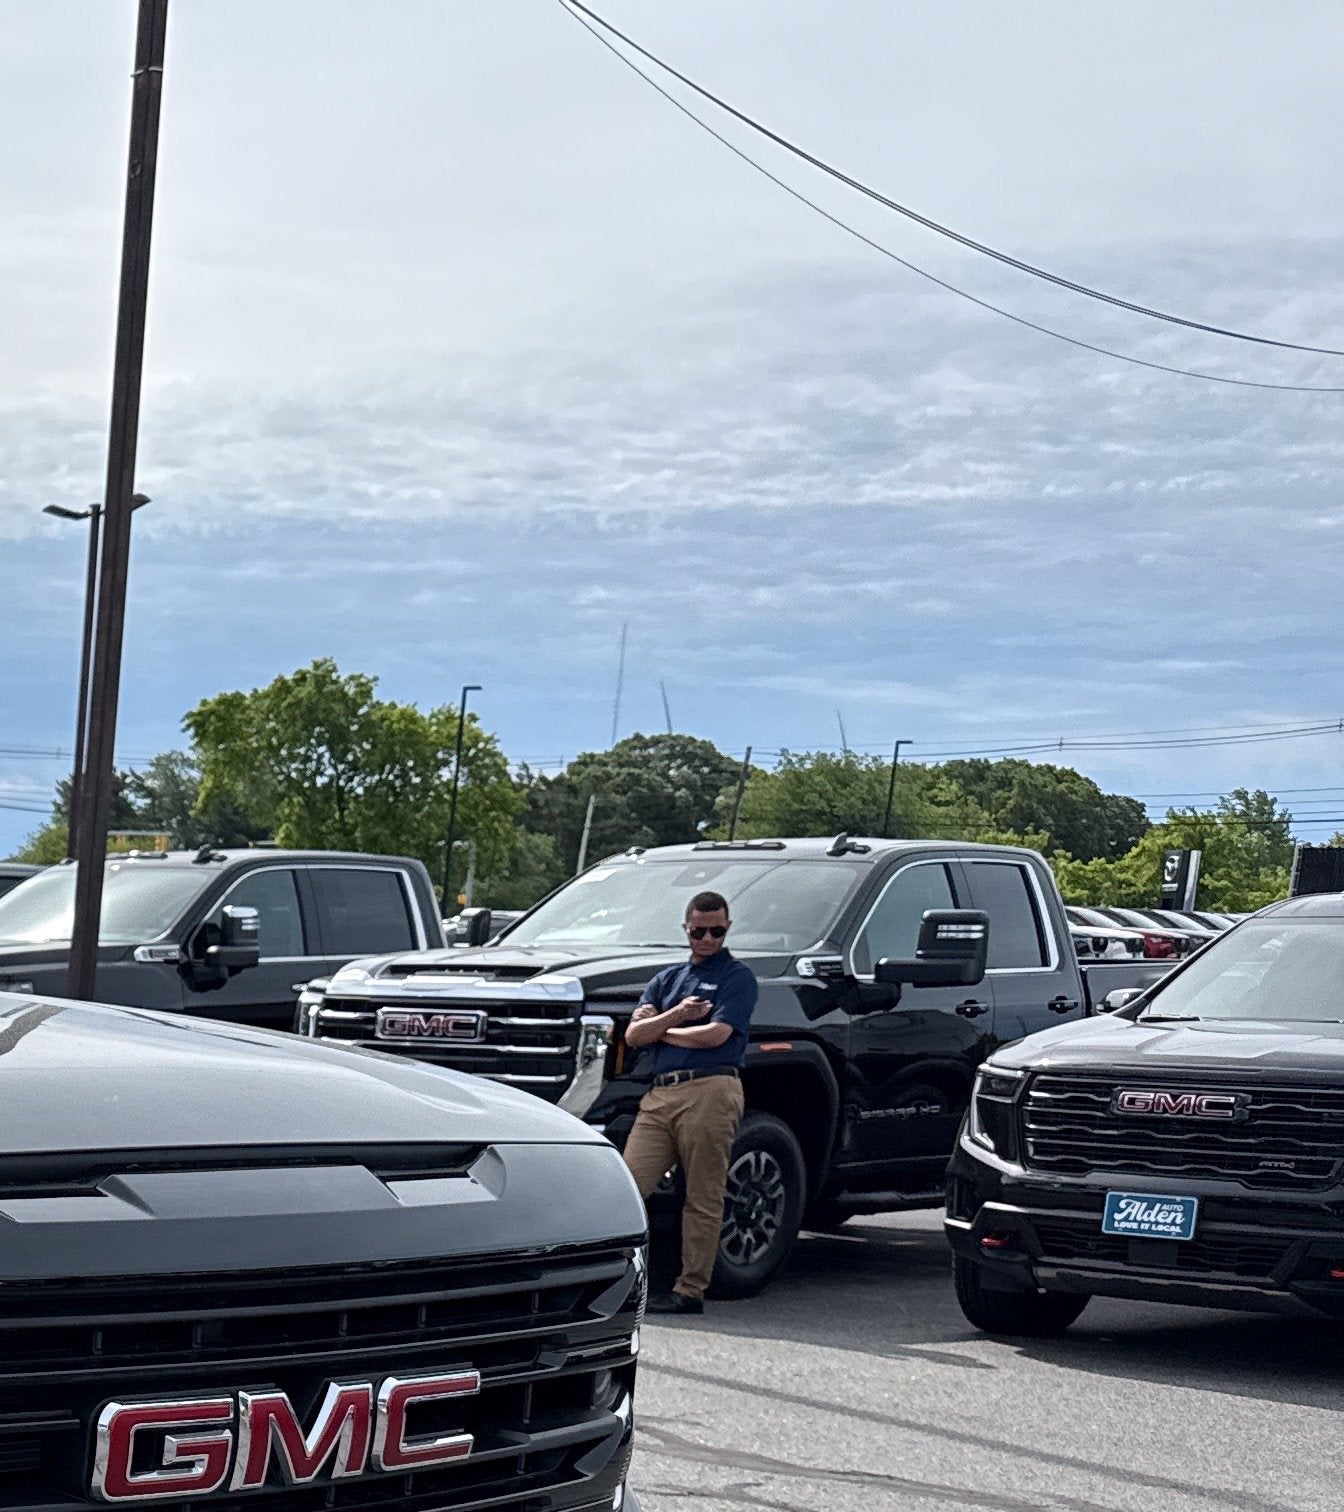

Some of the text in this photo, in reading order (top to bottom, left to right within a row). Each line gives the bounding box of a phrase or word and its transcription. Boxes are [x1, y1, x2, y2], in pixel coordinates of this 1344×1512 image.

[383, 1013, 477, 1037] GMC
[1118, 1091, 1235, 1117] GMC
[1113, 1199, 1185, 1224] Alden
[1161, 1203, 1184, 1211] AUTO
[1113, 1221, 1138, 1230] LOVE
[1151, 1223, 1182, 1232] LOCAL
[91, 1370, 480, 1501] GMC
